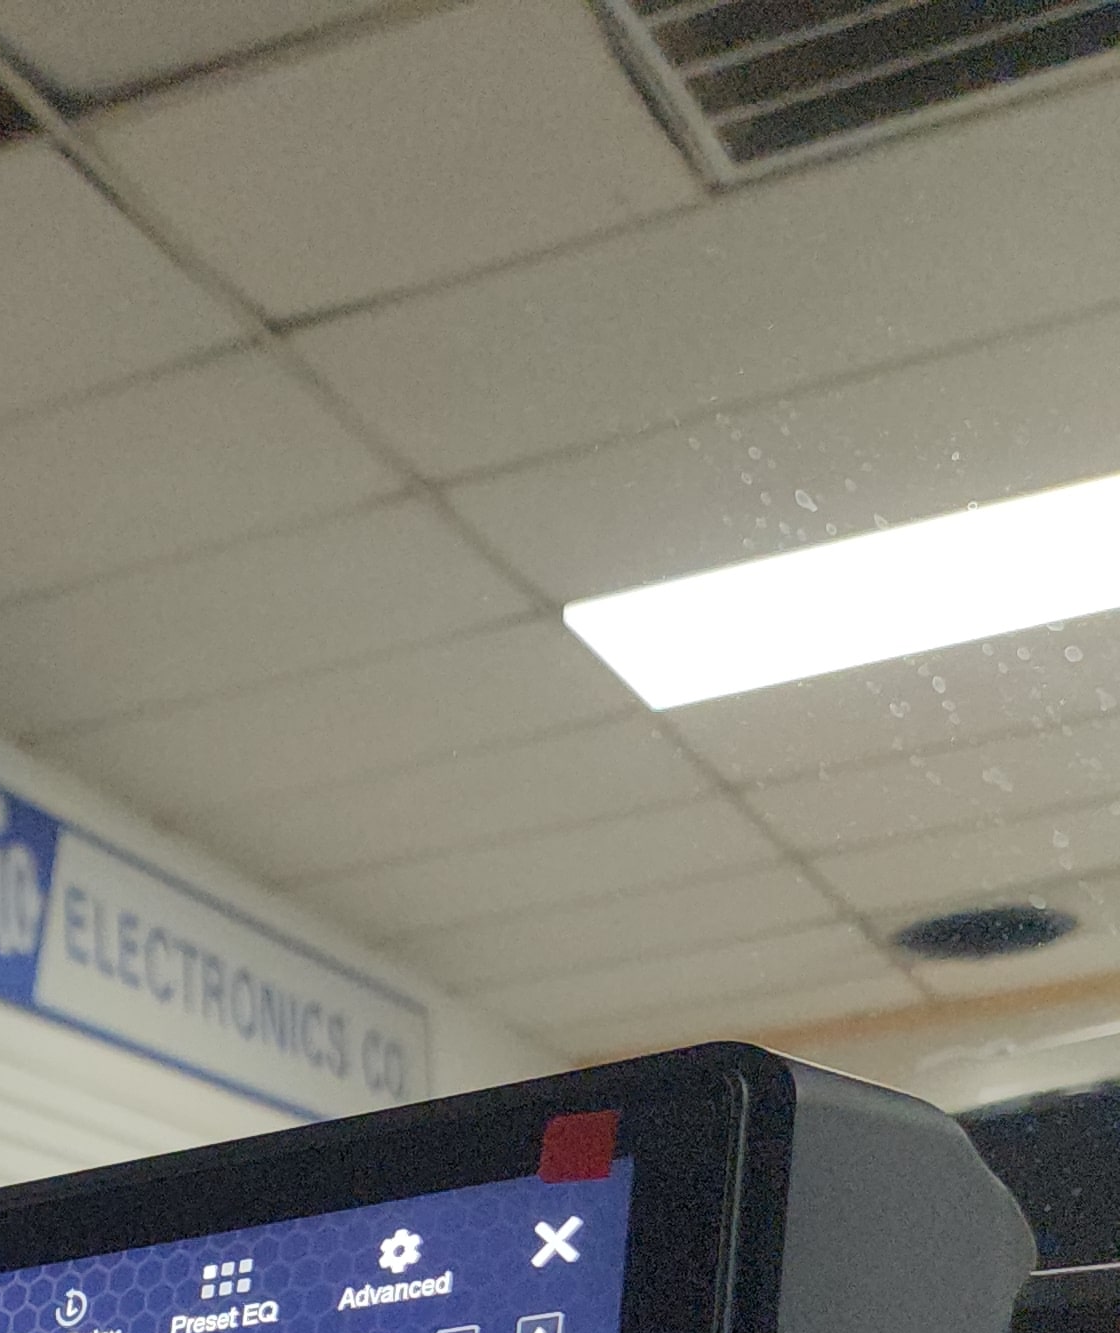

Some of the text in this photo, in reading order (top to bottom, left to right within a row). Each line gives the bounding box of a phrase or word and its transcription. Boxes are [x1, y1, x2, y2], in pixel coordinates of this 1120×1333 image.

[63, 885, 348, 1079] ELECTRONICS
[338, 1271, 454, 1311] Advanced
[242, 1300, 279, 1327] EQ
